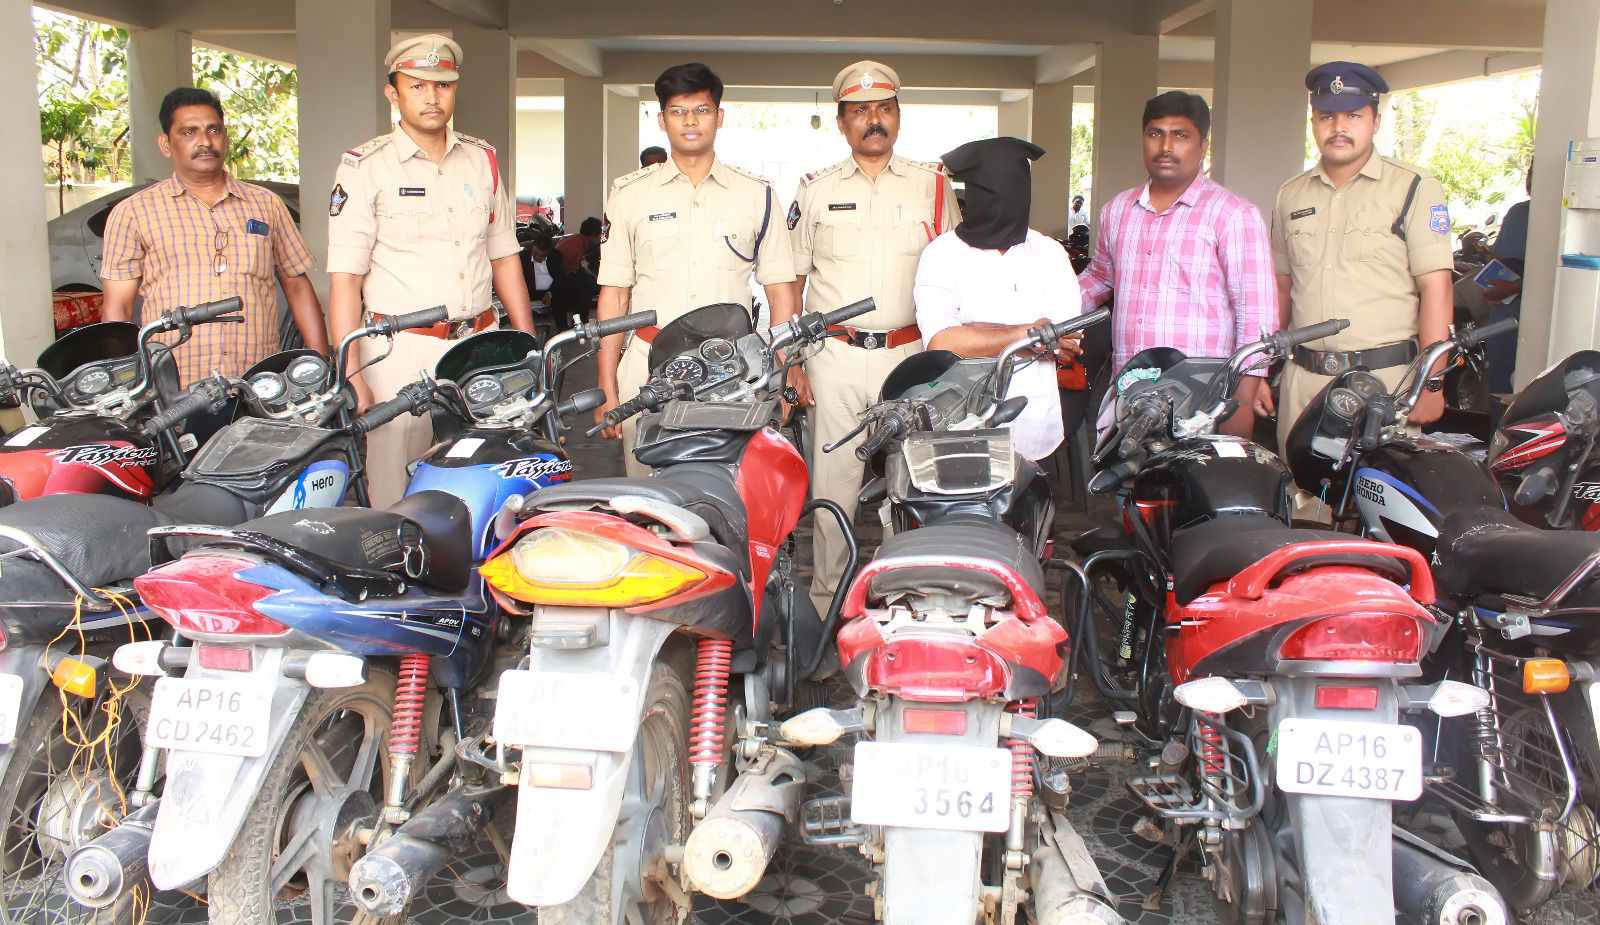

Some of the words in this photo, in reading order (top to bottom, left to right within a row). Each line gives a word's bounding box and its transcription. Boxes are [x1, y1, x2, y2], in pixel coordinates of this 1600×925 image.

[120, 459, 157, 469] PRO
[311, 475, 334, 491] Hero
[1358, 476, 1384, 494] HERO
[1356, 484, 1386, 507] HONDA
[176, 687, 242, 713] AP16
[1314, 731, 1387, 759] AP16
[894, 754, 970, 784] AP16
[913, 787, 995, 819] 3564
